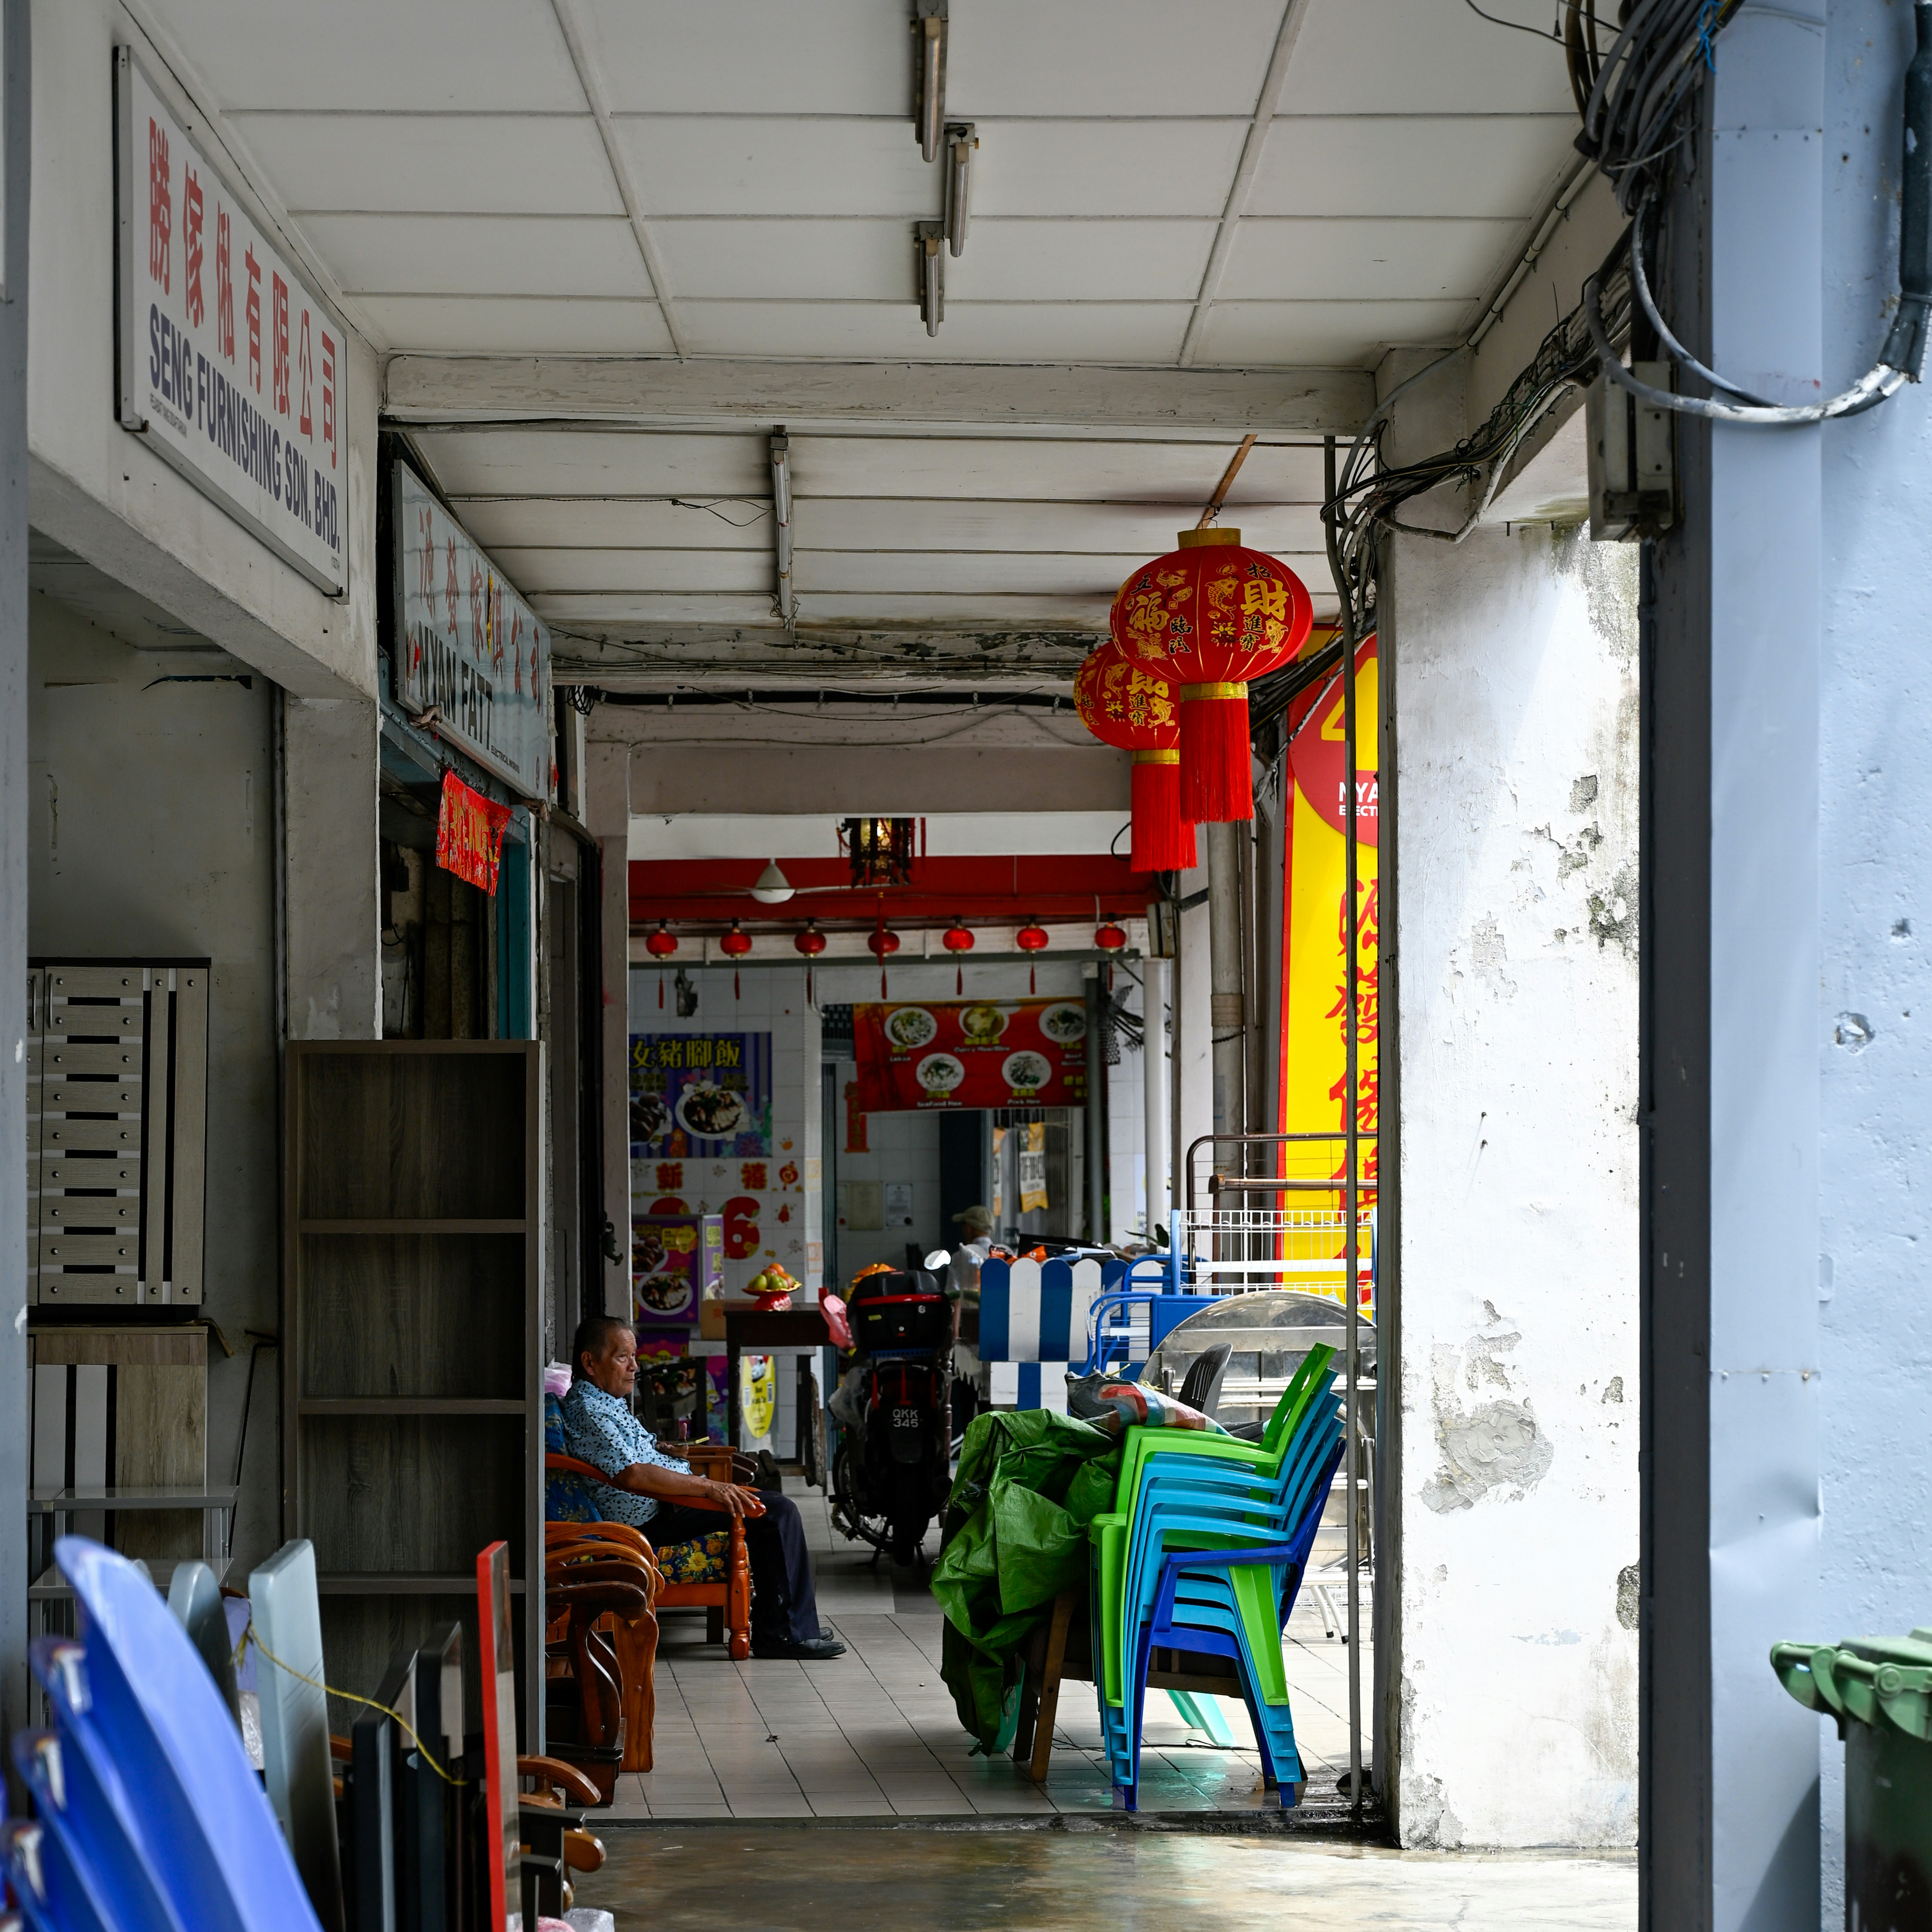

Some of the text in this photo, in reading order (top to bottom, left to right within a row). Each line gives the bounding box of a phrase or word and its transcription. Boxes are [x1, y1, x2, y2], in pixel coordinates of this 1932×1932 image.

[150, 303, 192, 420] SENG
[197, 351, 281, 501] FURNISHING
[285, 440, 311, 529] SDN.
[315, 469, 340, 554] BHD.
[418, 620, 492, 751] NYAN FATT
[491, 745, 509, 765] ELECTRICAL
[892, 1409, 918, 1418] QKK
[893, 1418, 919, 1428] 345
